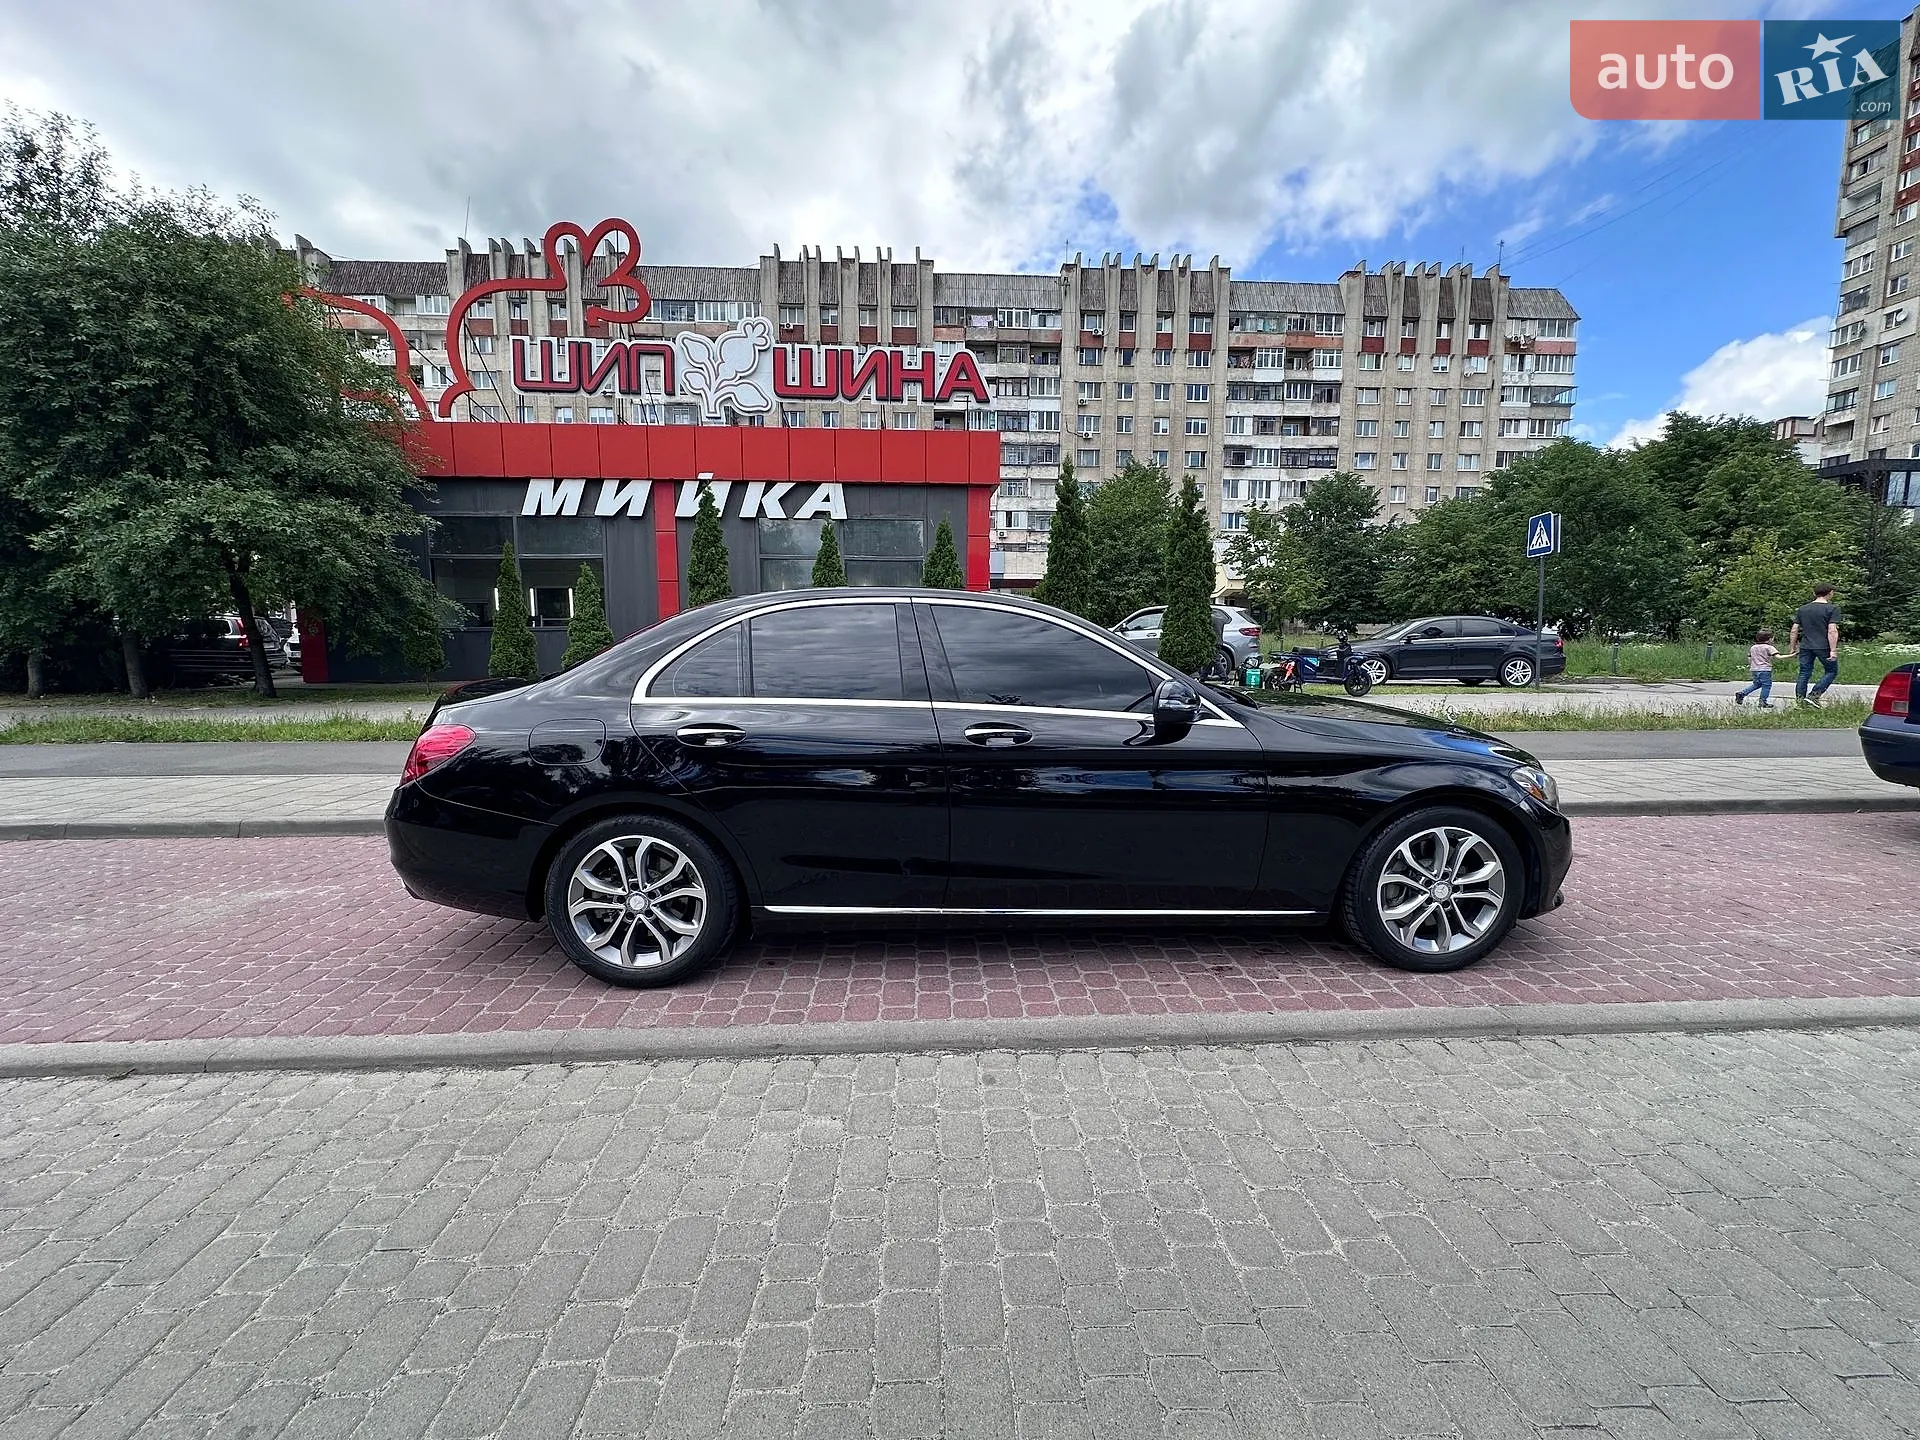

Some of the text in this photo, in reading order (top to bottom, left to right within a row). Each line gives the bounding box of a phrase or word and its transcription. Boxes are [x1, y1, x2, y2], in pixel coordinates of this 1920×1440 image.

[512, 338, 990, 403] ШИП ШИНА
[521, 472, 848, 520] МИЙКА
